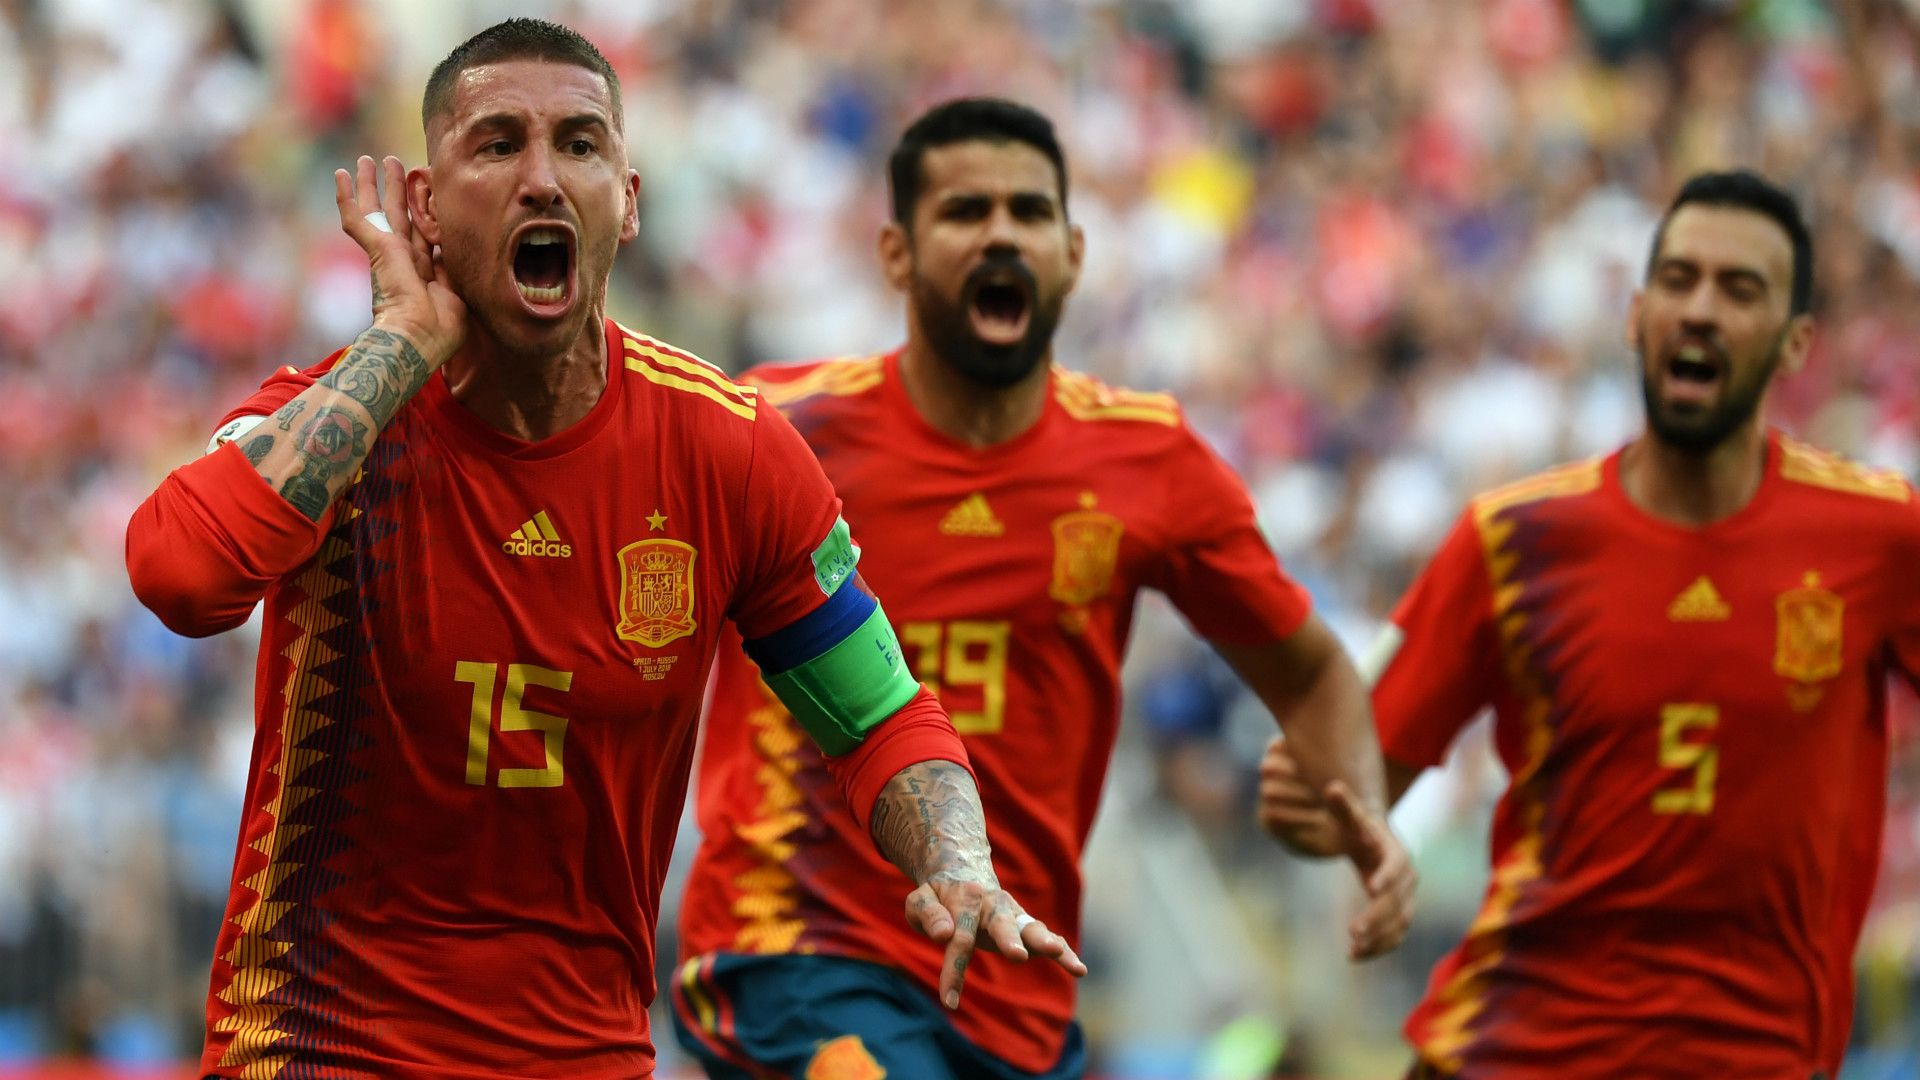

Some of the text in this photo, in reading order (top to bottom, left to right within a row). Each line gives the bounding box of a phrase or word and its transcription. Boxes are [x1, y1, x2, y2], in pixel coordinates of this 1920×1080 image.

[502, 539, 572, 558] adidas
[454, 660, 573, 788] 15
[643, 665, 658, 673] JULY
[903, 622, 1009, 735] 19
[1652, 702, 1719, 816] 5
